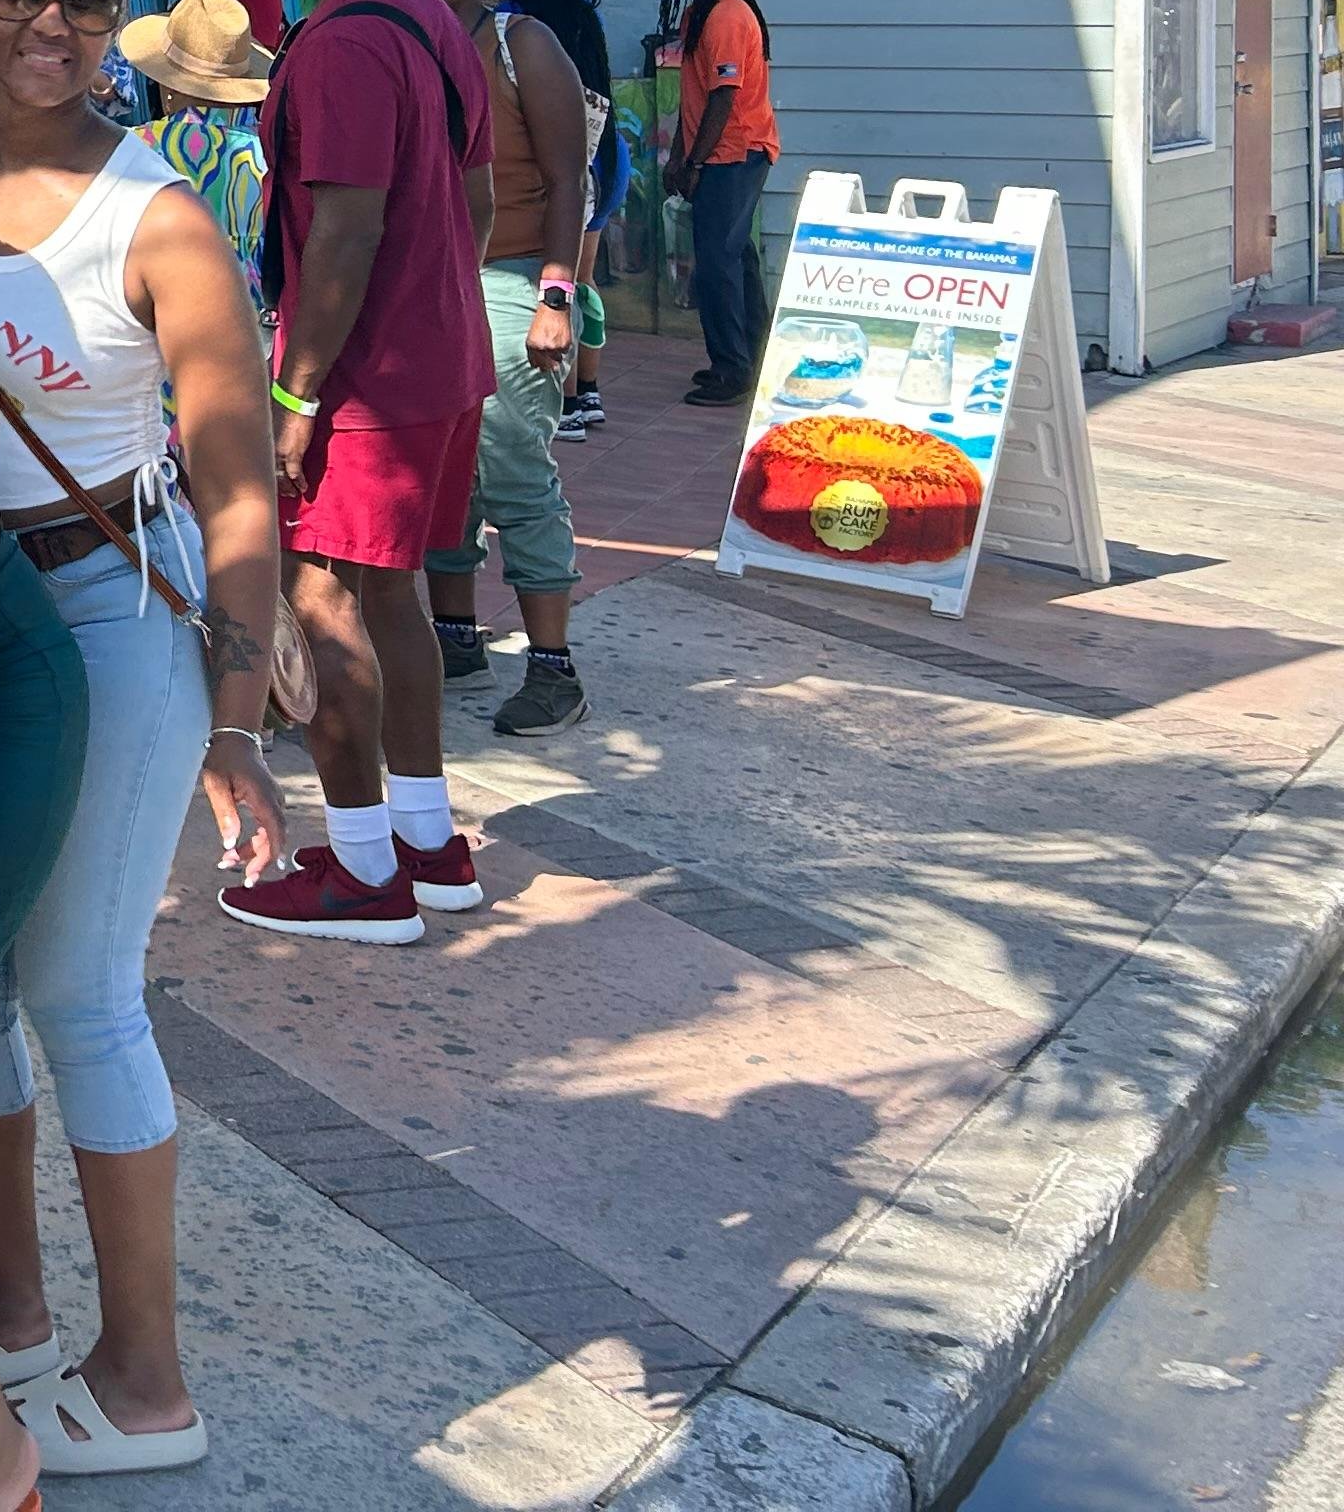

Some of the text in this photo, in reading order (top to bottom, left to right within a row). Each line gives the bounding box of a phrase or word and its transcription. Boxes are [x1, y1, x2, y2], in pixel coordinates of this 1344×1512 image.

[809, 236, 1018, 266] THE OFFICIAL RUM CAKE OF THE BAHAMAS
[802, 262, 1010, 310] We're OPEN
[795, 294, 1003, 326] FREE SAMPLES AVAILABLE INSIDE
[845, 496, 883, 508] BAHAMAS
[842, 503, 881, 521] RUM
[838, 527, 874, 539] FACTORY
[840, 516, 879, 532] CAKE
